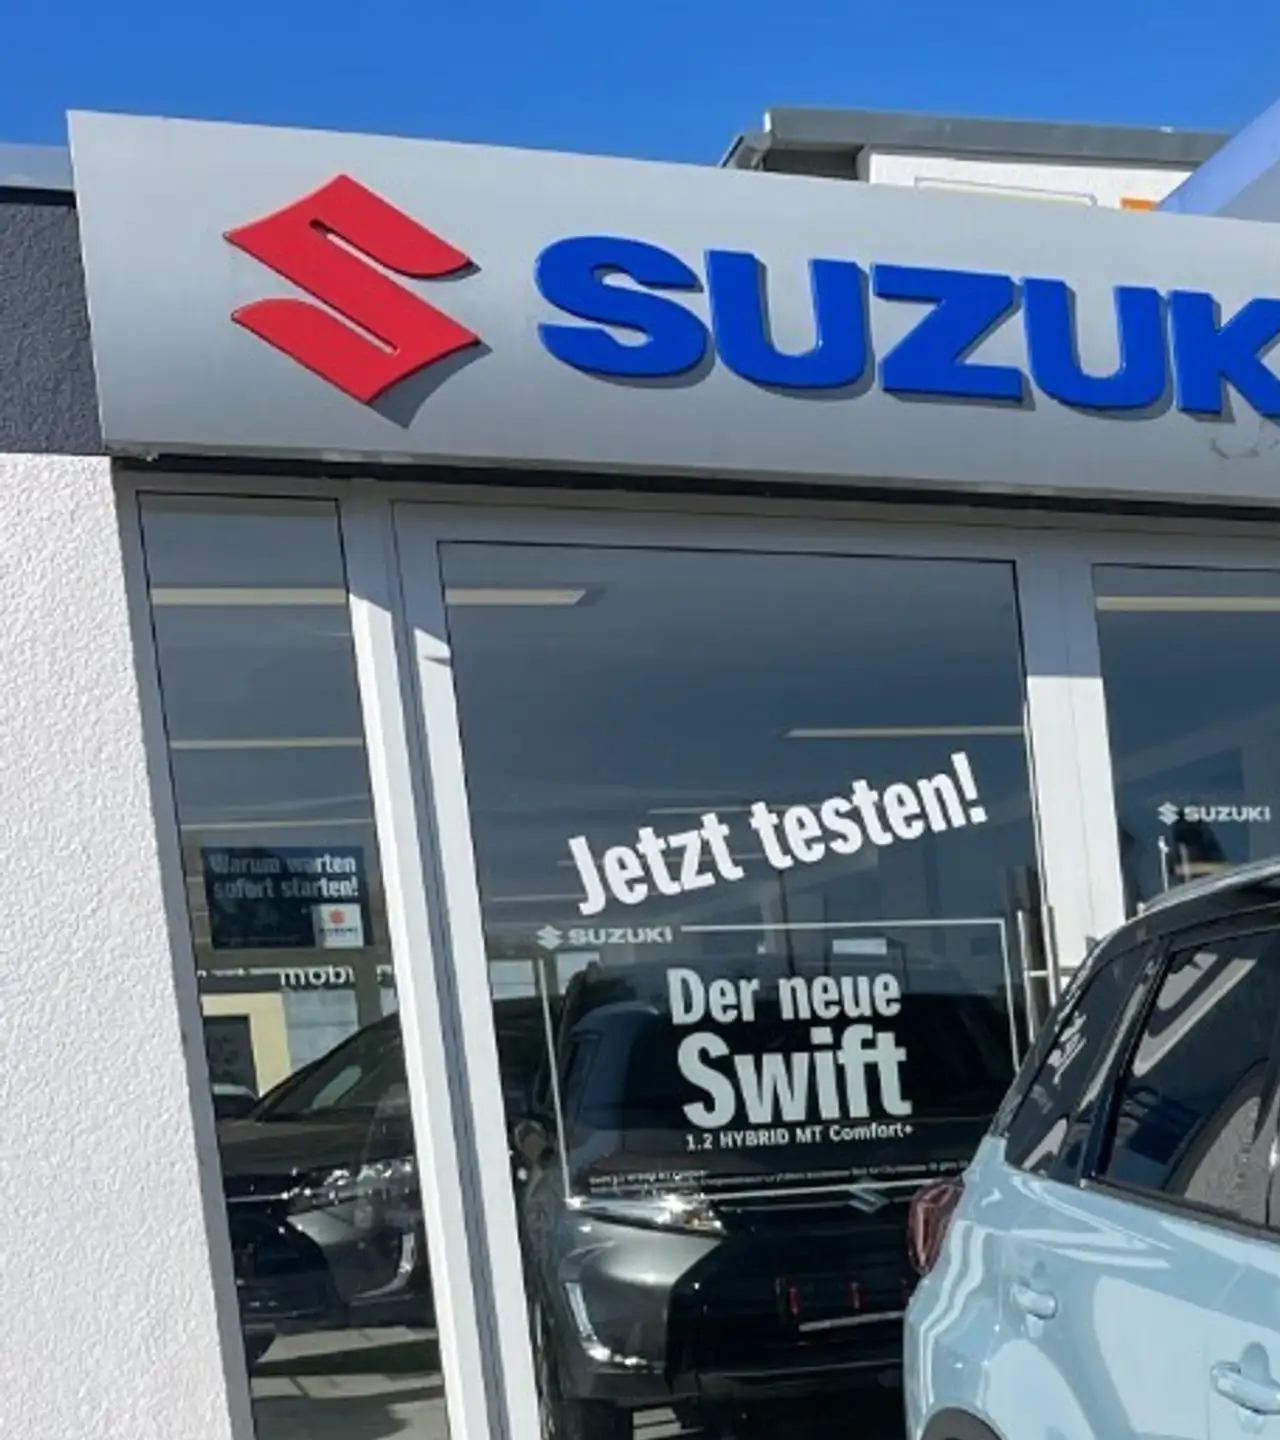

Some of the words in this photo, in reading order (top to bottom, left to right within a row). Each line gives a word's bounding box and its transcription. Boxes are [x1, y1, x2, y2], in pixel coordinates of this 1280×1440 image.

[568, 811, 745, 916] Jetzt
[749, 751, 989, 871] testen!
[1183, 805, 1271, 823] SUZUKI
[568, 926, 673, 946] SUZUKI
[666, 967, 760, 1025] Der
[778, 972, 901, 1021] neue
[676, 1024, 913, 1130] Swift
[685, 1133, 714, 1151] 1.2
[719, 1129, 790, 1149] HYBRID
[795, 1125, 824, 1143] MT
[829, 1121, 914, 1142] Comfort+
